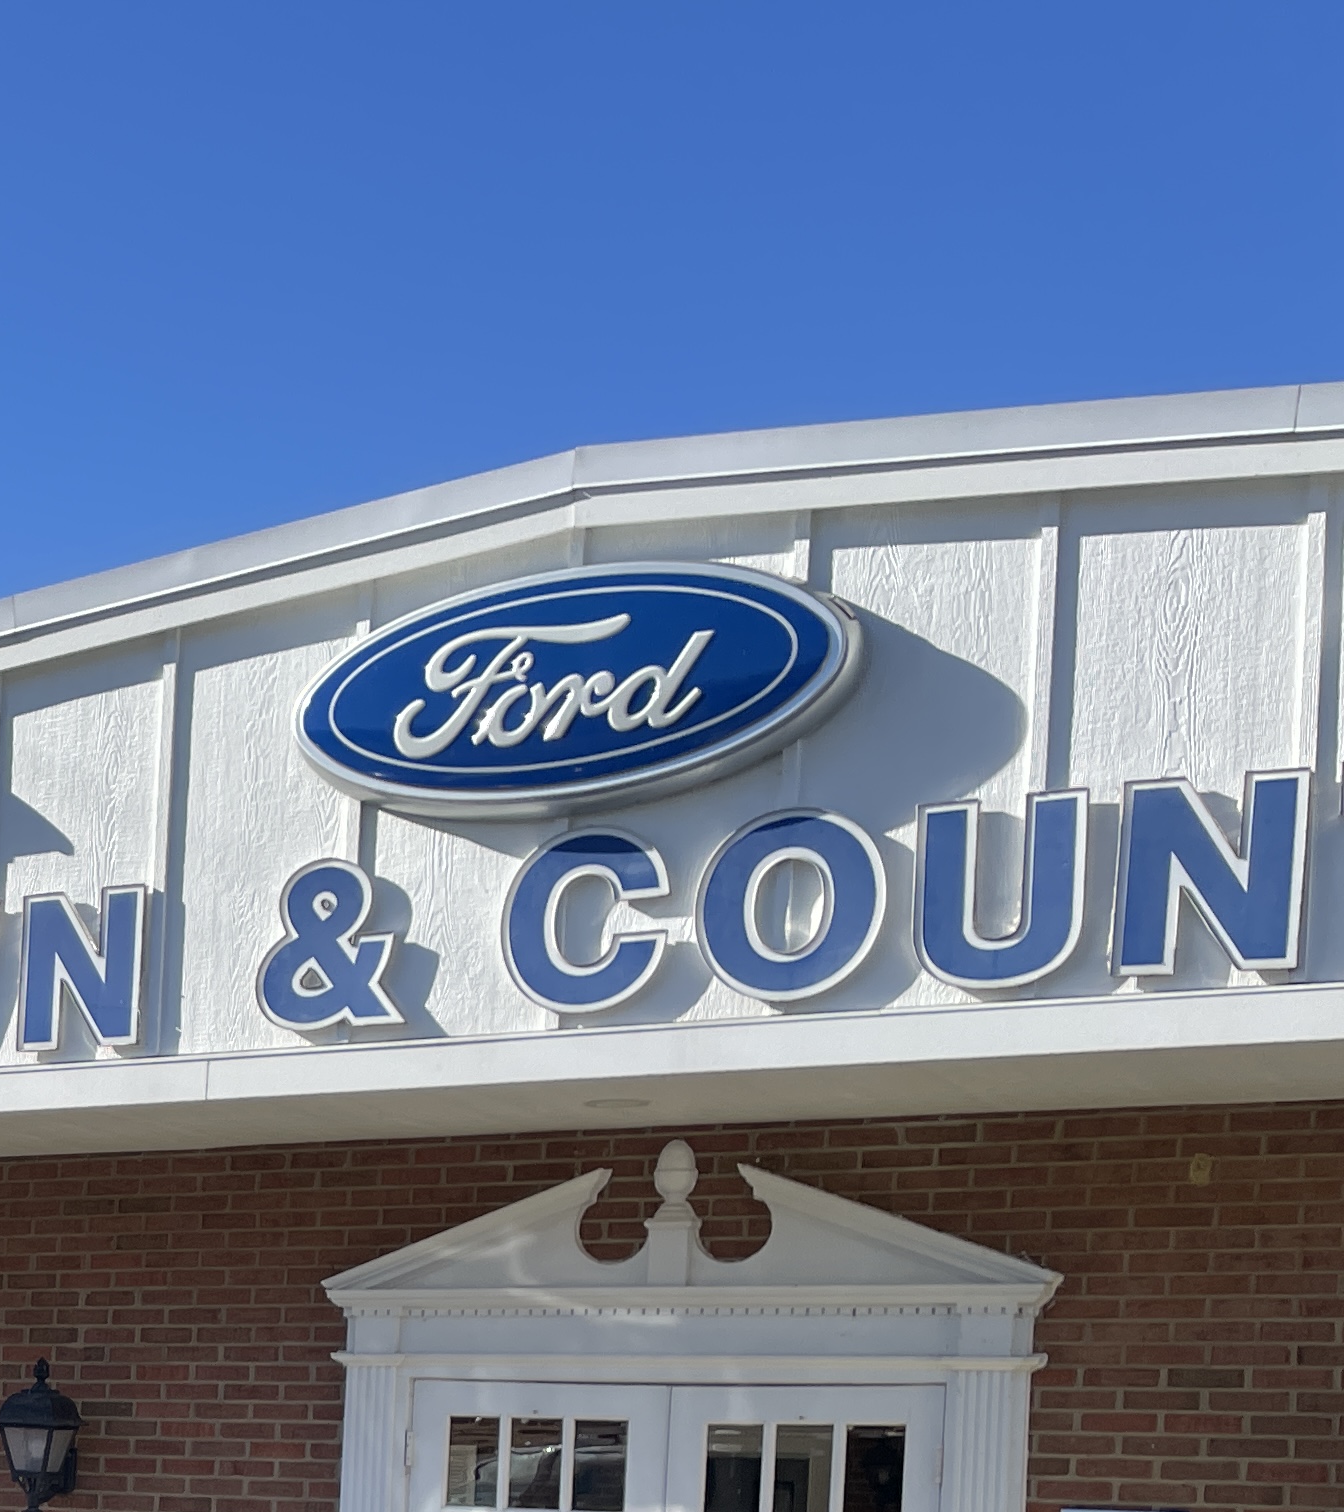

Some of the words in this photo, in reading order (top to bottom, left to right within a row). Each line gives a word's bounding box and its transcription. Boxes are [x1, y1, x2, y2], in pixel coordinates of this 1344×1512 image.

[394, 612, 715, 759] Ford
[257, 857, 406, 1031] &
[502, 767, 1344, 1014] COUN
